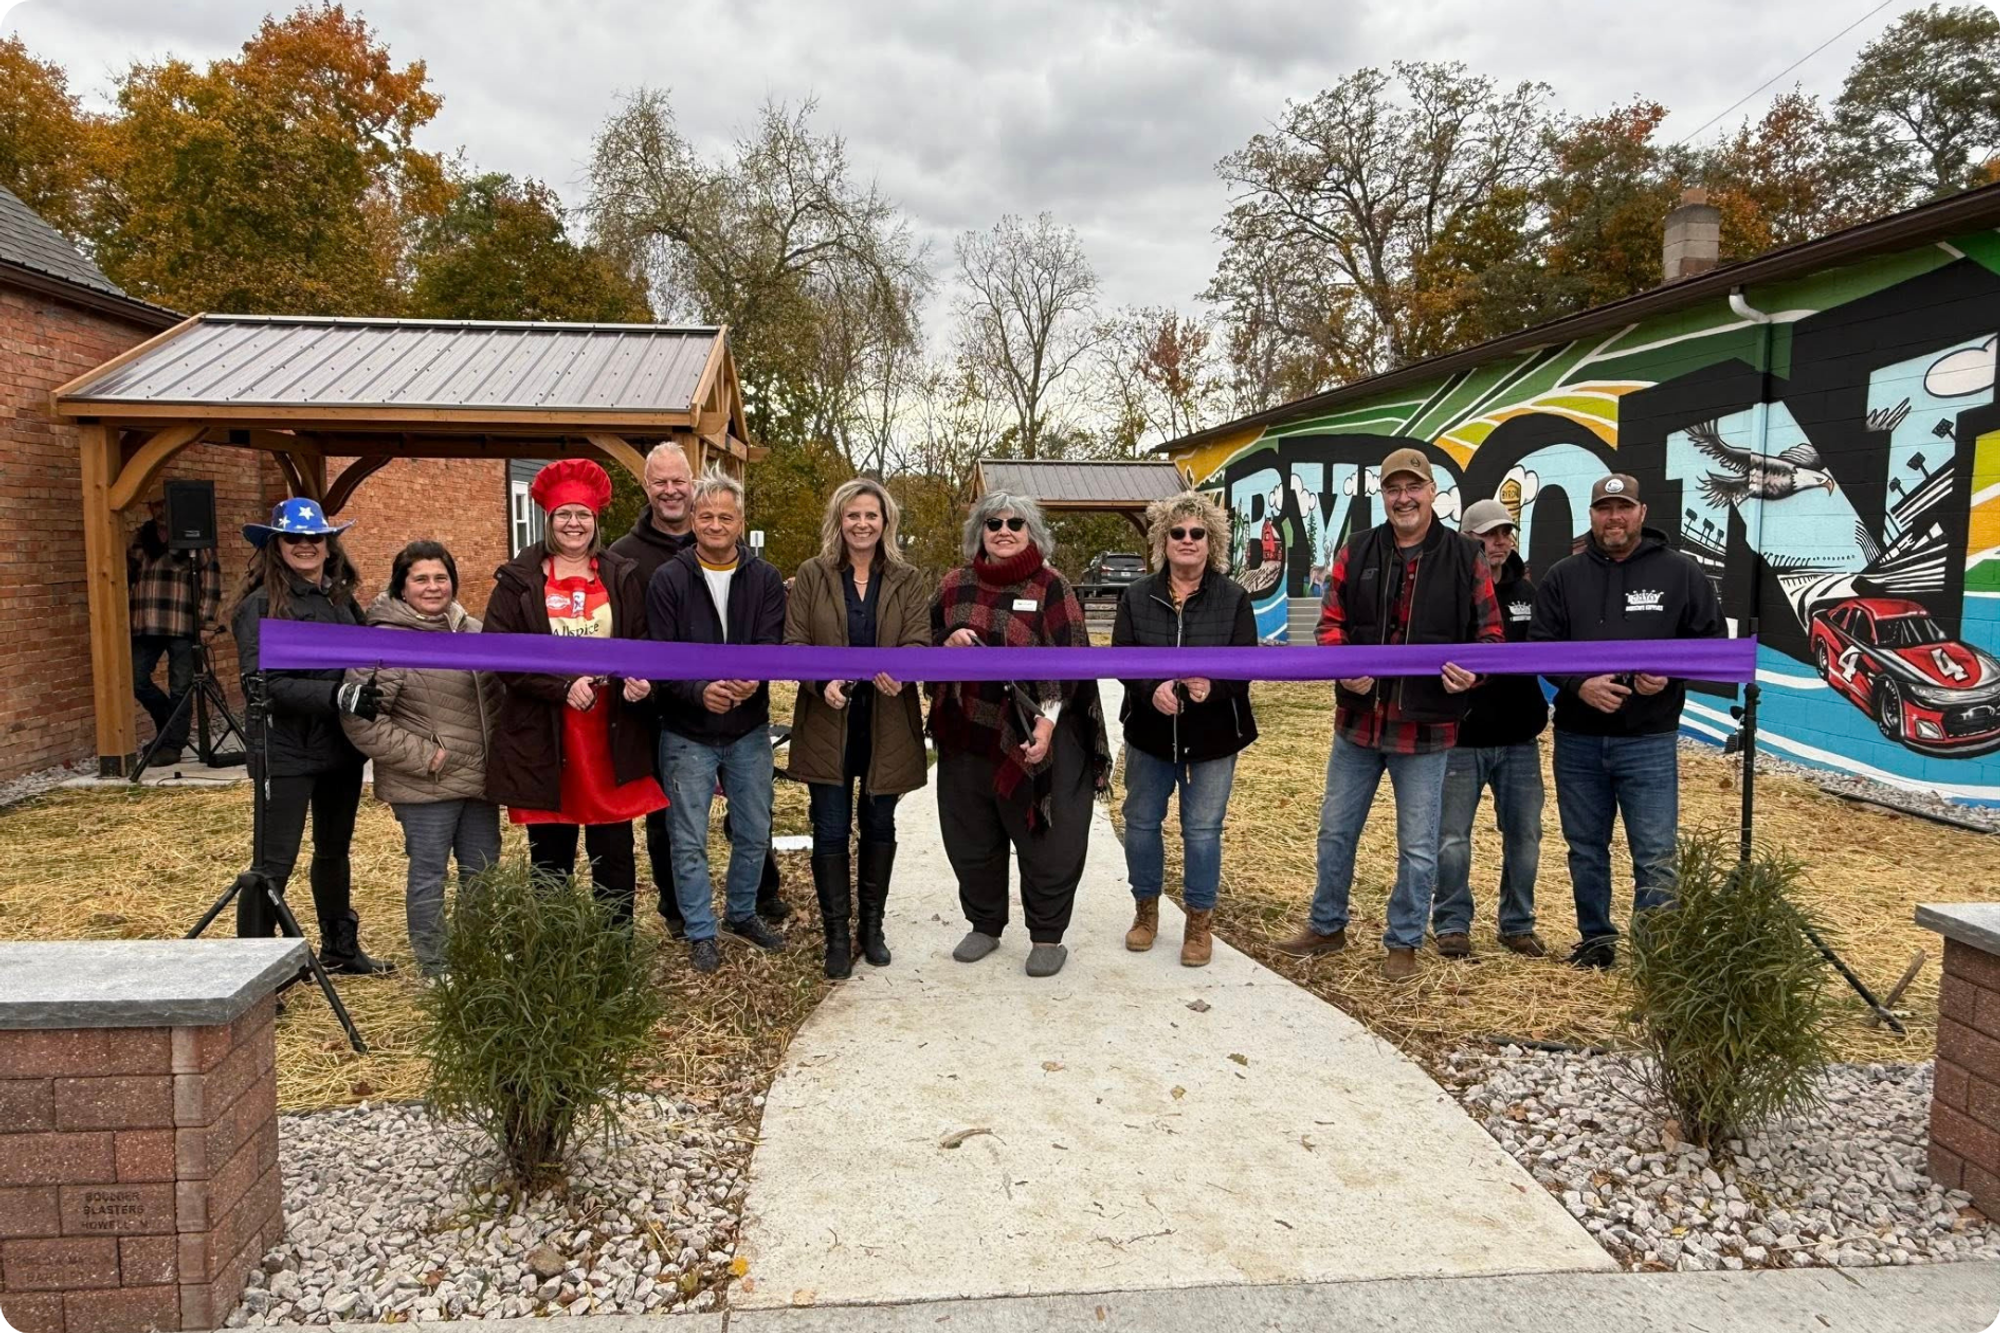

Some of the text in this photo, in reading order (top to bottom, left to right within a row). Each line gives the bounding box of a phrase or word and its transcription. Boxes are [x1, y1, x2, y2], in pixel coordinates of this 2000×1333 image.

[1838, 645, 1863, 683] 4
[1931, 648, 1969, 681] 4
[83, 1205, 145, 1215] BLASTERS
